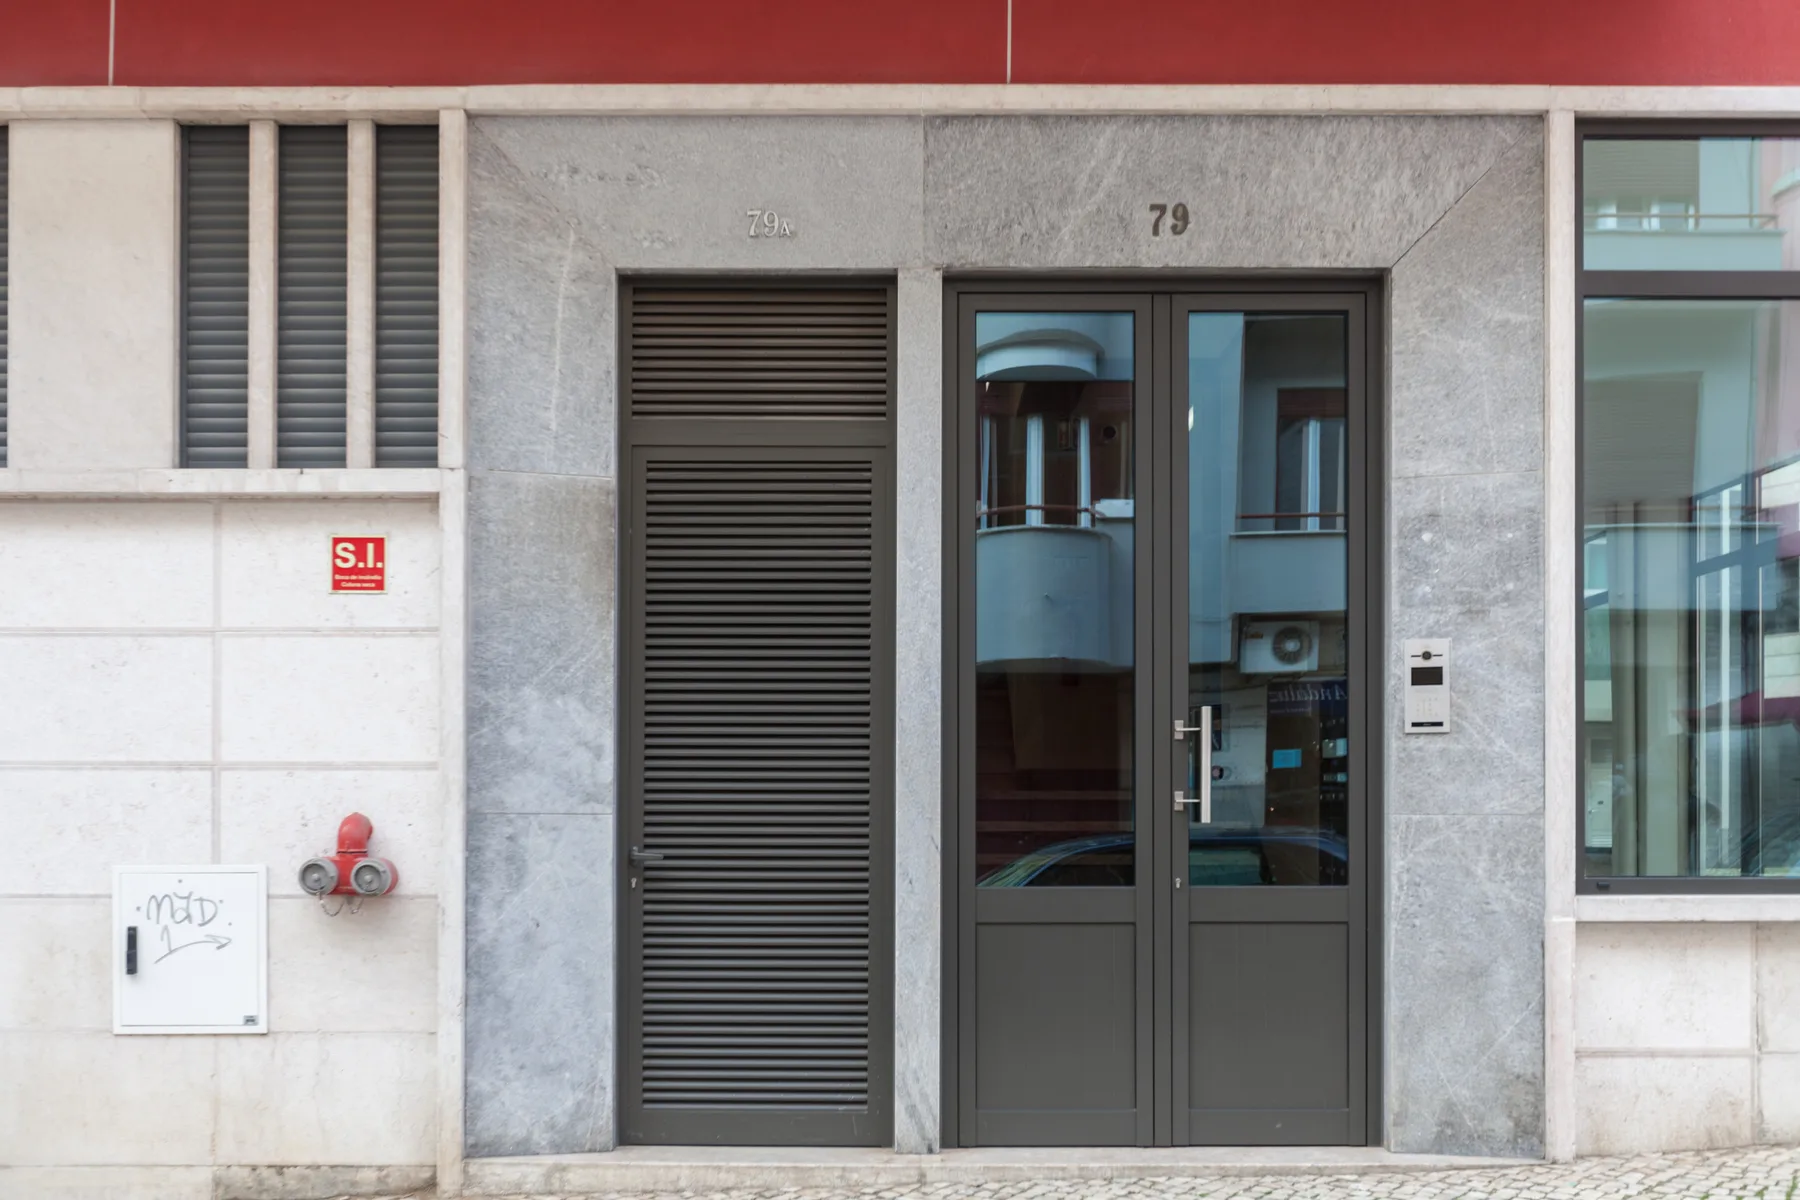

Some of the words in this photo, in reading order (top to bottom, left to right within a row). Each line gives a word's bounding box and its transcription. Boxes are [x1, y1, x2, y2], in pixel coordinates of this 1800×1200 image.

[747, 209, 791, 237] 79A
[1149, 202, 1190, 237] 79
[334, 541, 383, 568] S.I.
